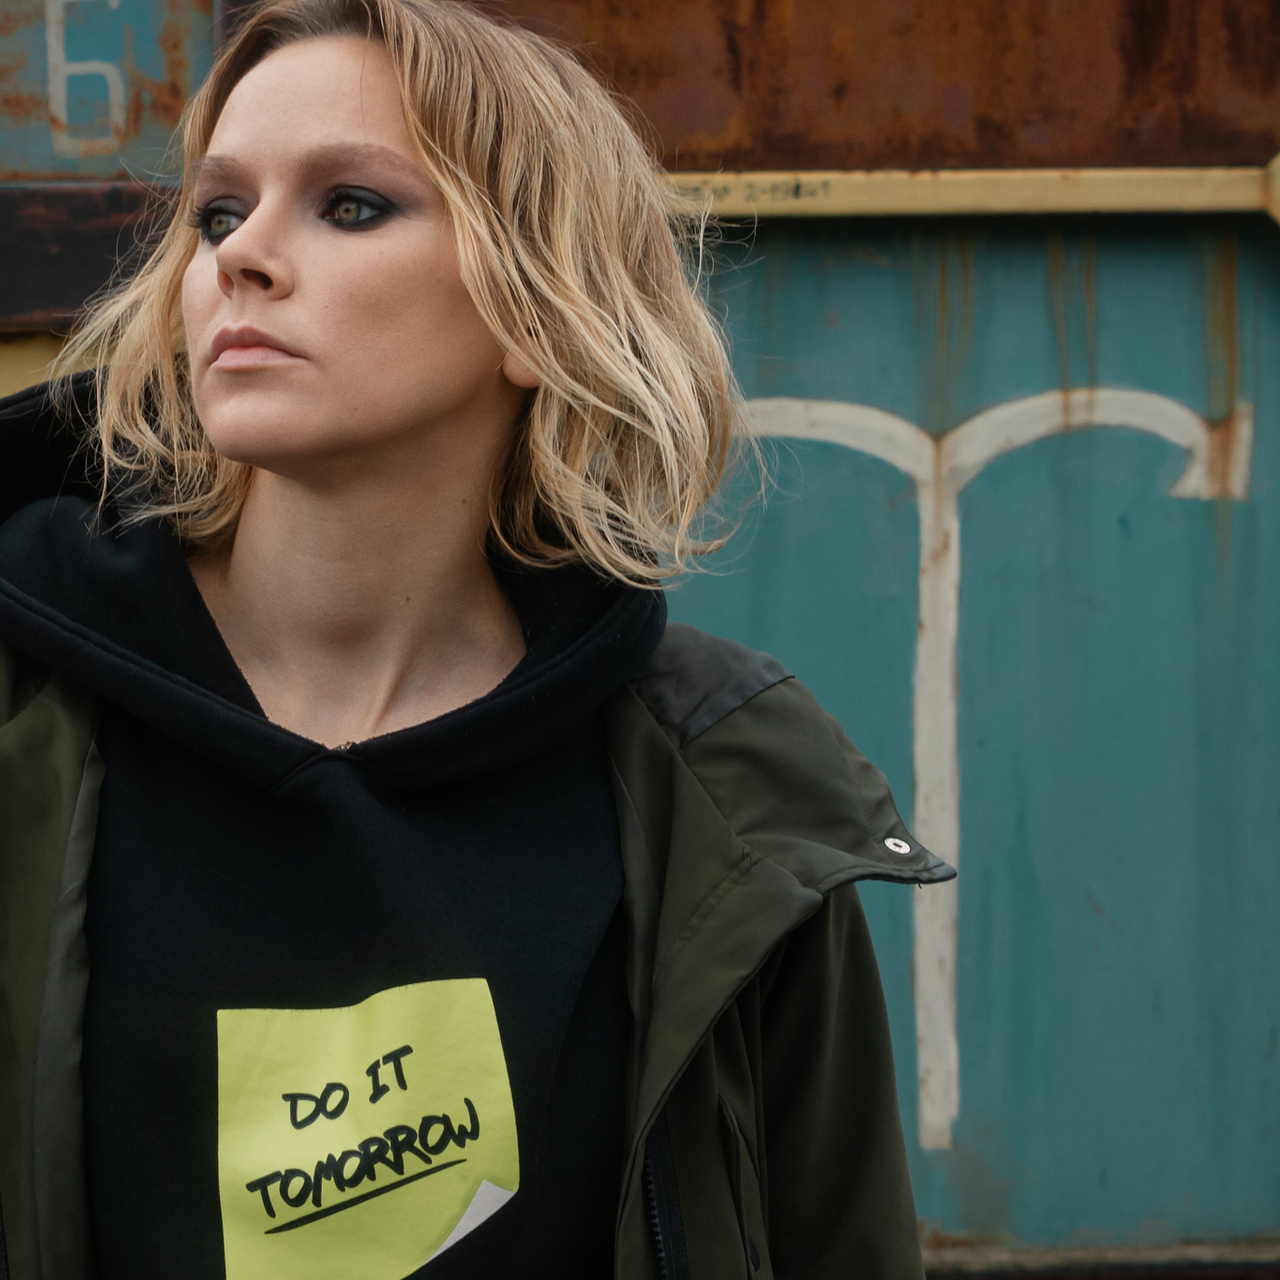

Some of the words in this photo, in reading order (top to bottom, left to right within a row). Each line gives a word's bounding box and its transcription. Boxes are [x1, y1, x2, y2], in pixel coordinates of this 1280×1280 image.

[282, 1082, 350, 1130] DO
[366, 1045, 413, 1104] IT
[246, 1097, 480, 1218] TOMORROW
